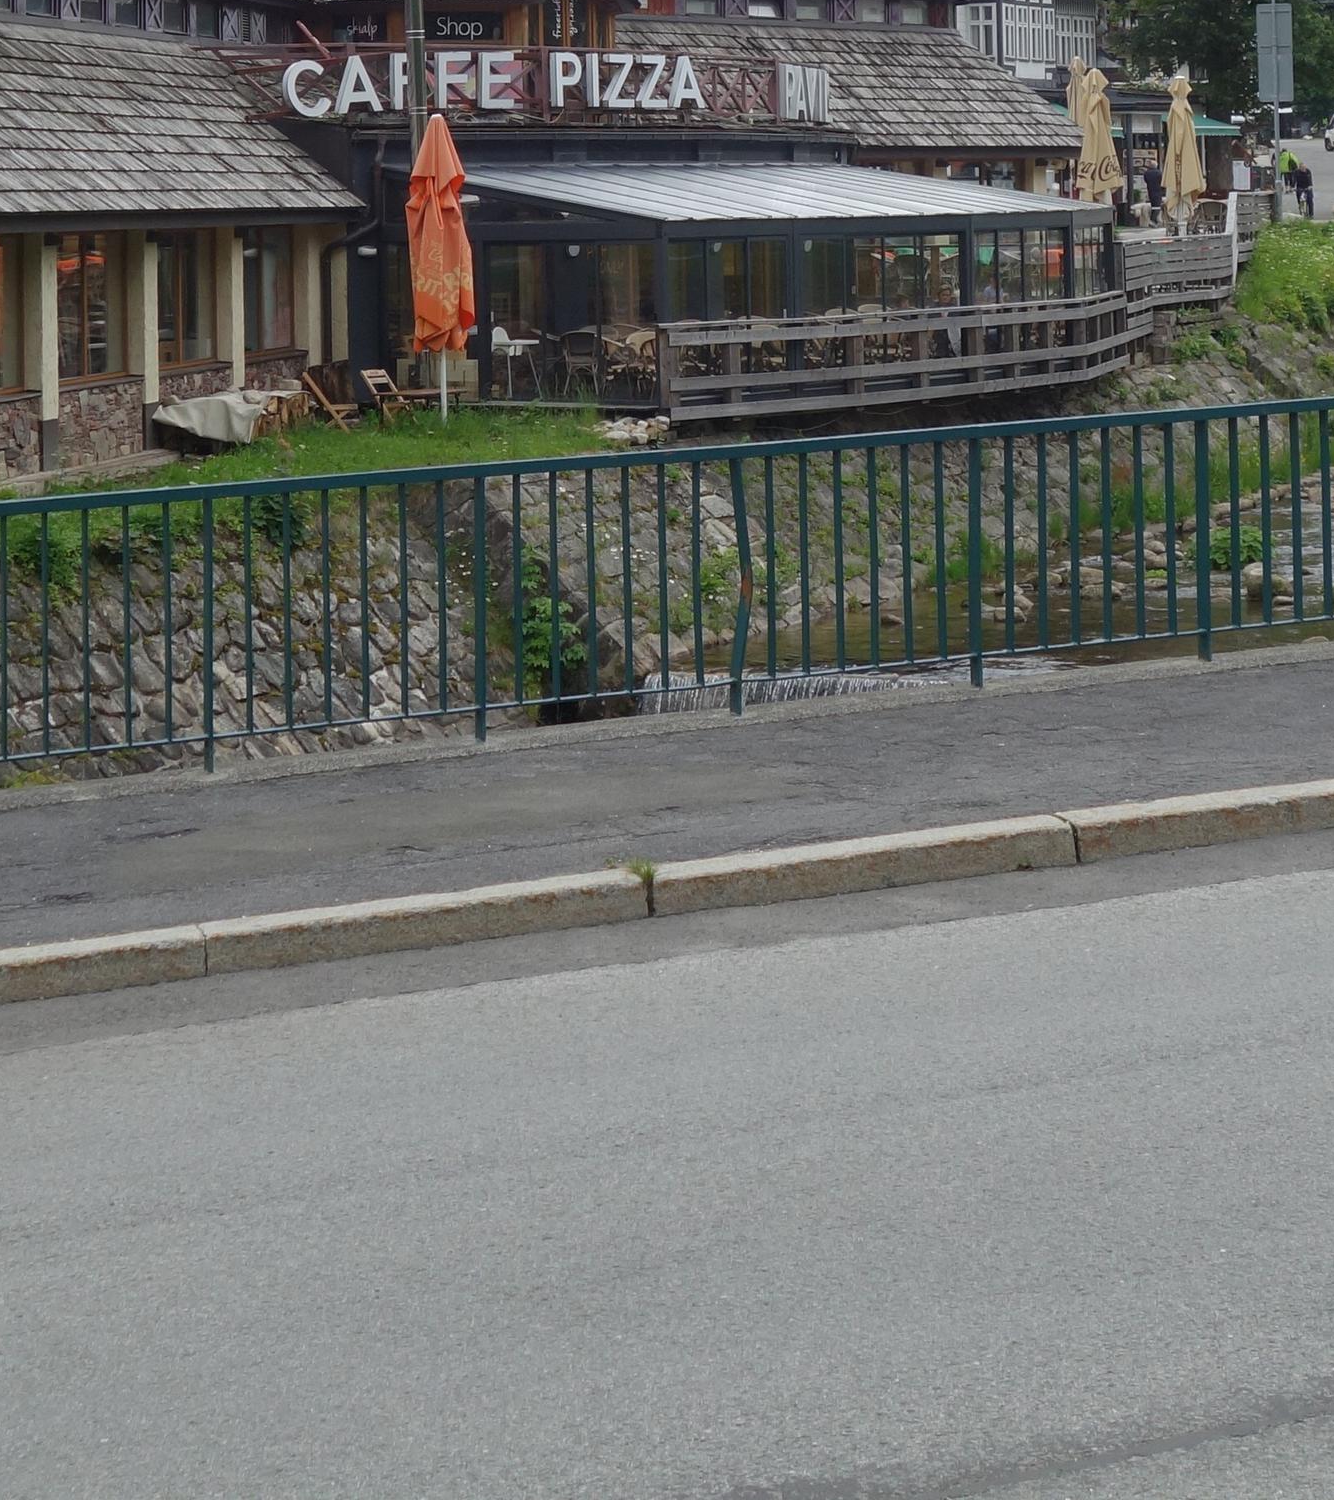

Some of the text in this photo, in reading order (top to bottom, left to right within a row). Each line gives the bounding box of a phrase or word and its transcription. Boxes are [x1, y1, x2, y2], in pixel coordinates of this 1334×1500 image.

[346, 15, 378, 41] skialp
[436, 16, 483, 41] Shop
[549, 51, 707, 109] PIZZA
